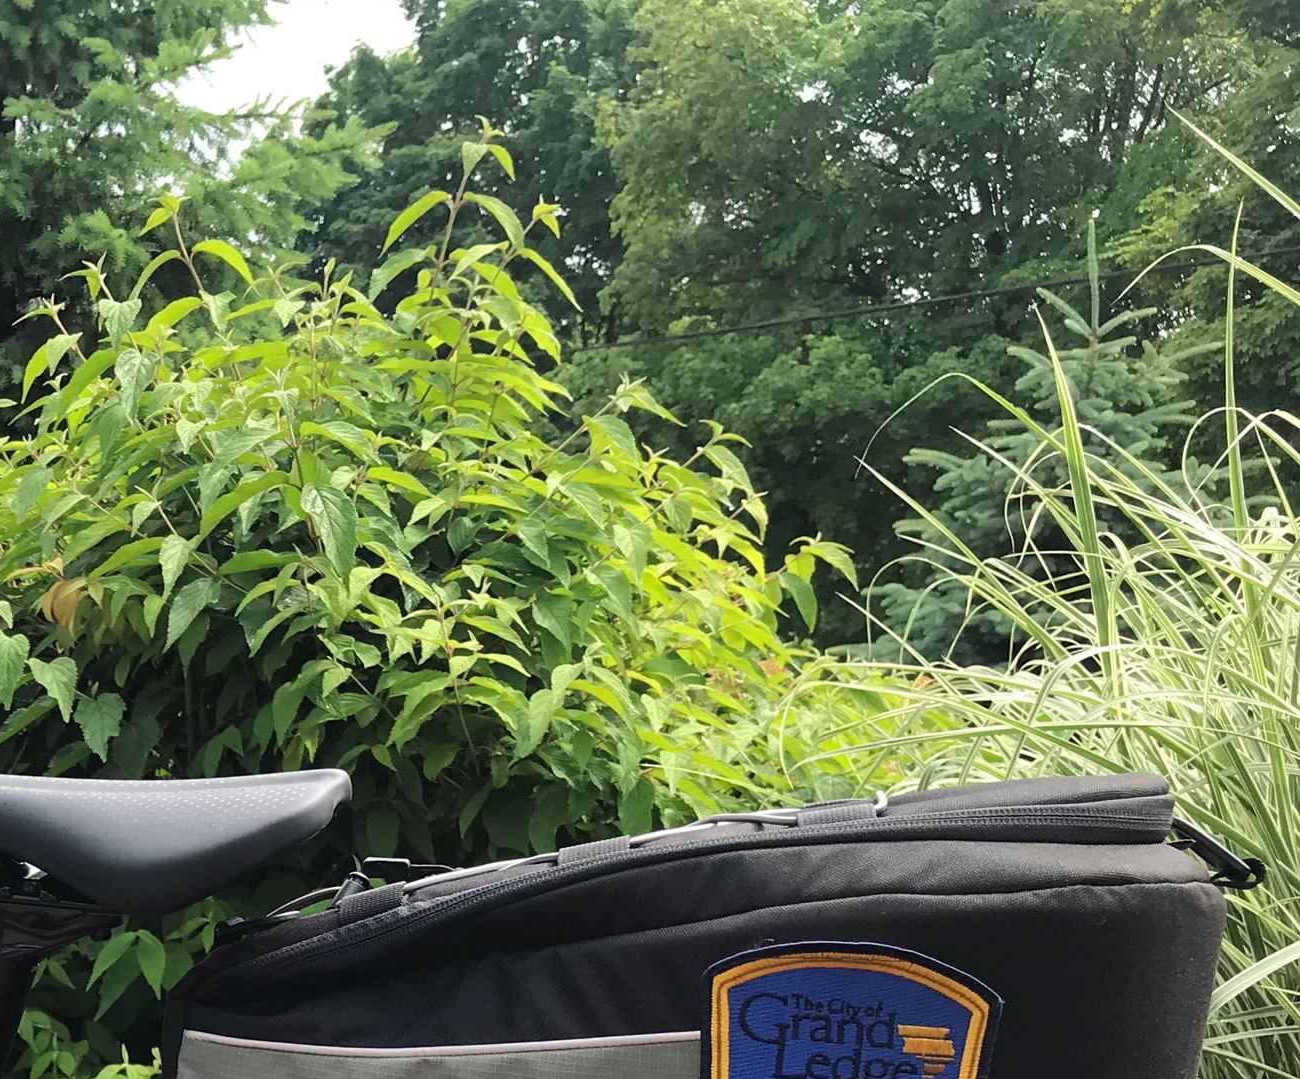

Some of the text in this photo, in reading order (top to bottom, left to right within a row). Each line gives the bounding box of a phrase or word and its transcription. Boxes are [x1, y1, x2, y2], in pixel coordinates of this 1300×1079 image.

[739, 992, 897, 1050] Grand
[791, 993, 884, 1018] The City of
